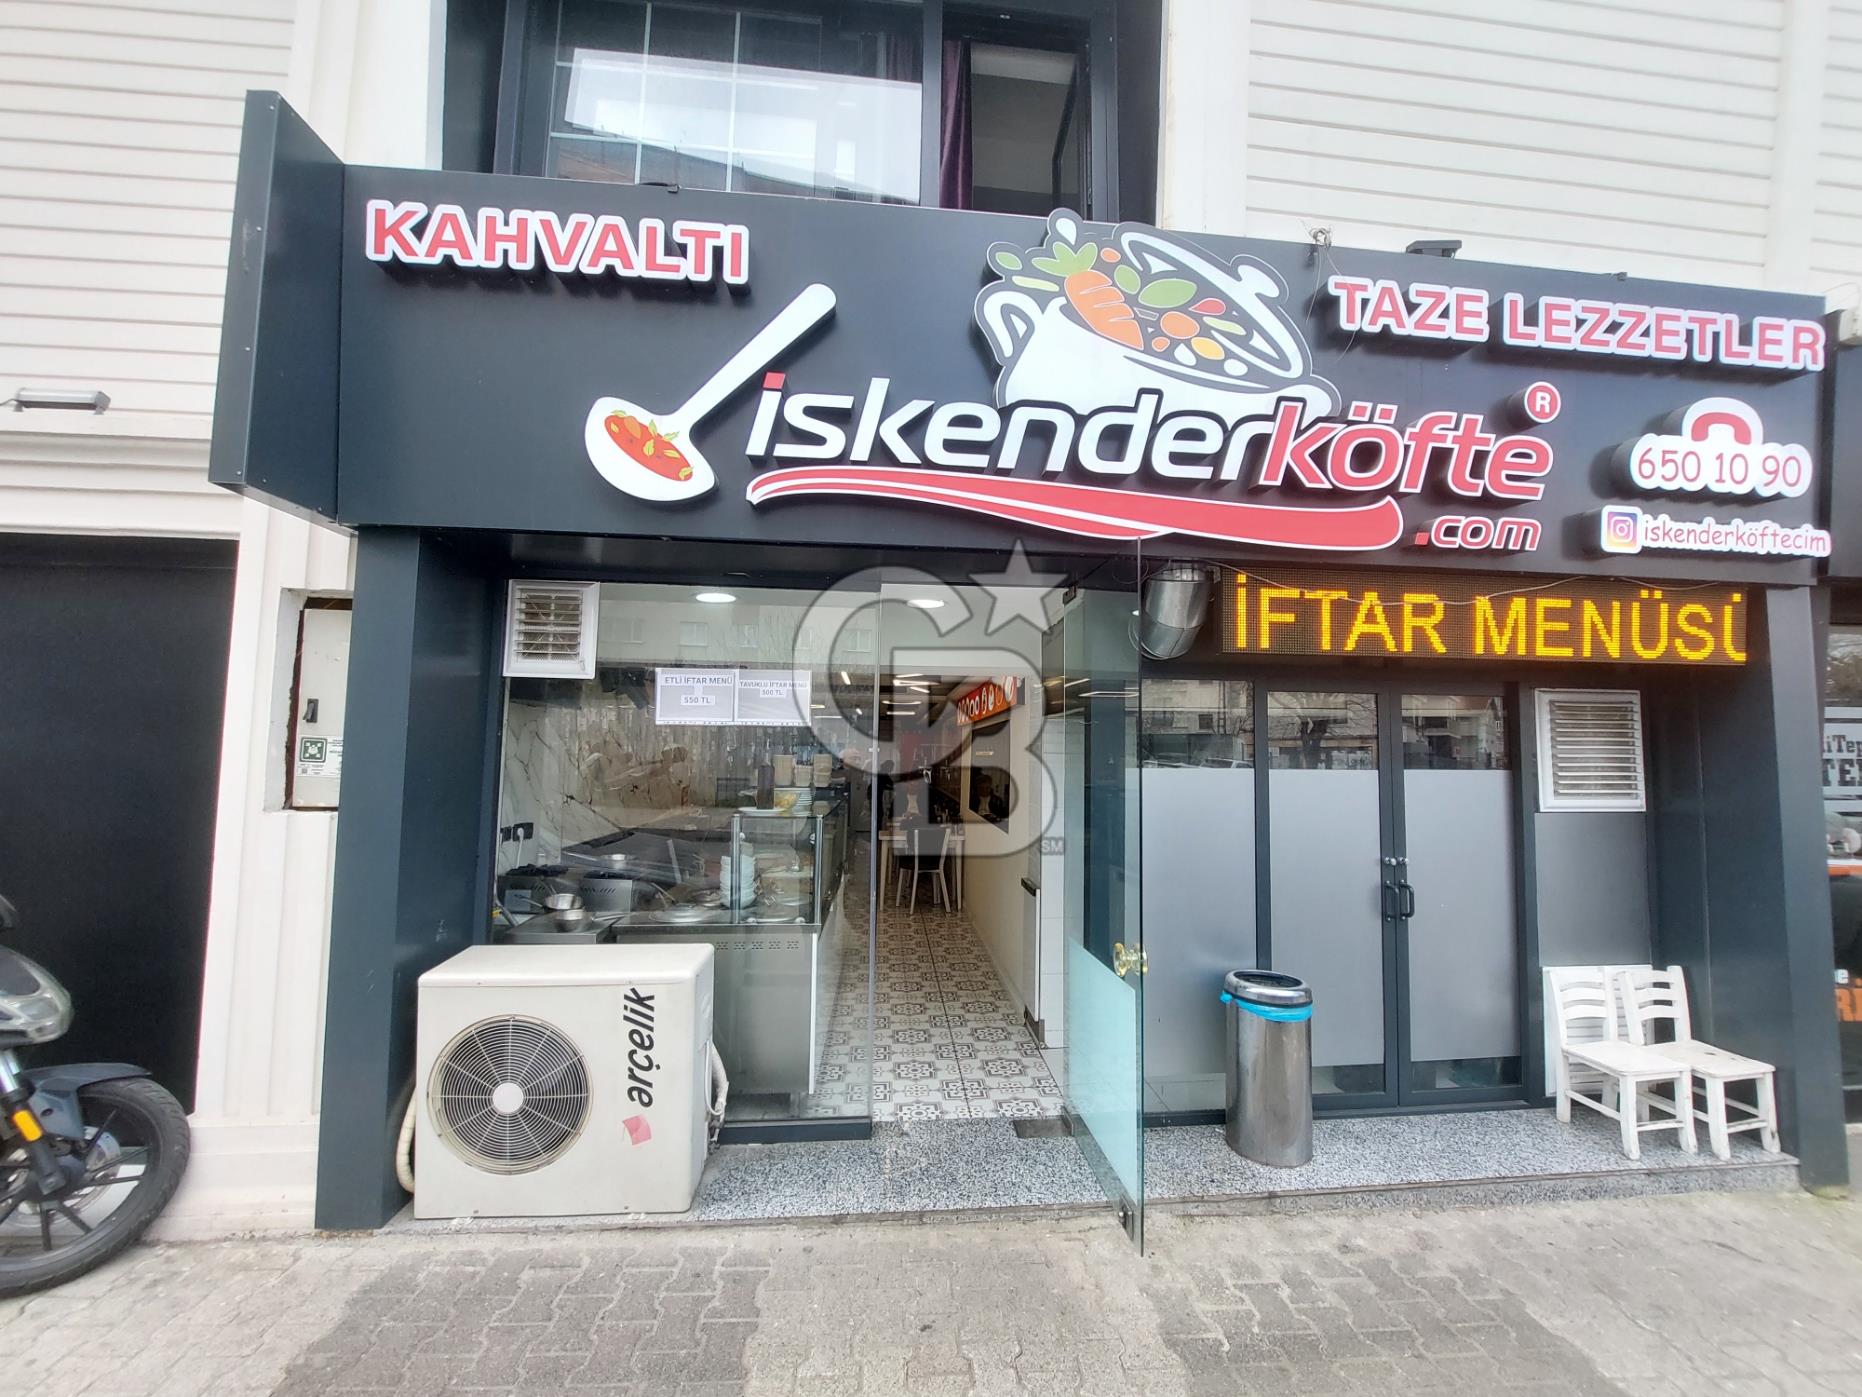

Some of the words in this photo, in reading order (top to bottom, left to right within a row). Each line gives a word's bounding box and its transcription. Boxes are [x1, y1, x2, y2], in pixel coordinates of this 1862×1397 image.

[366, 199, 749, 285] KAHVALTI
[1328, 276, 1489, 342] TAZE
[1503, 293, 1826, 371] LEZZETLER
[1638, 447, 1701, 483] 650
[1714, 452, 1749, 485] 10
[1762, 455, 1802, 488] 90
[1413, 514, 1542, 551] .com
[1644, 519, 1827, 553] iskenderköftecim
[1236, 573, 1447, 653] İFTAR
[664, 676, 683, 685] ETLİ
[684, 675, 707, 685] İFTAR
[709, 676, 733, 685] MENÜ
[683, 696, 699, 704] 550
[623, 987, 661, 1108] arçelik
